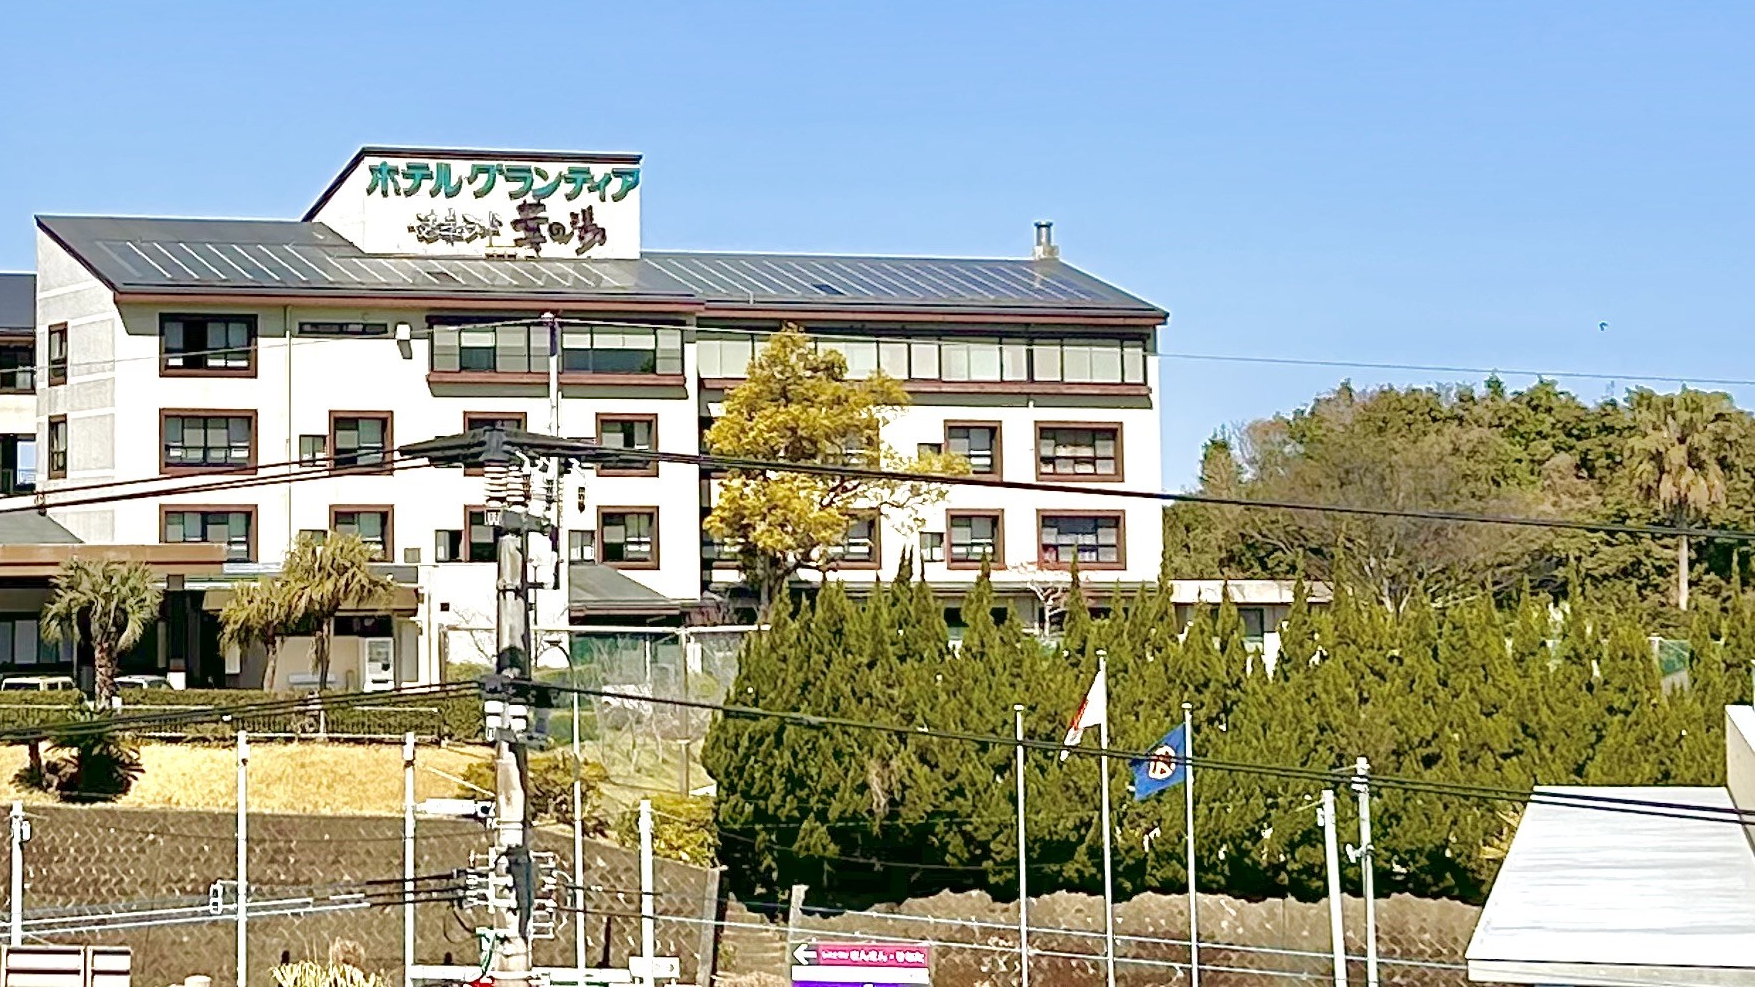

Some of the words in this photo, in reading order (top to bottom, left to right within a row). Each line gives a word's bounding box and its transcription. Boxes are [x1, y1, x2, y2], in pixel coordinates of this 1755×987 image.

[366, 161, 641, 202] ホテルグランティア
